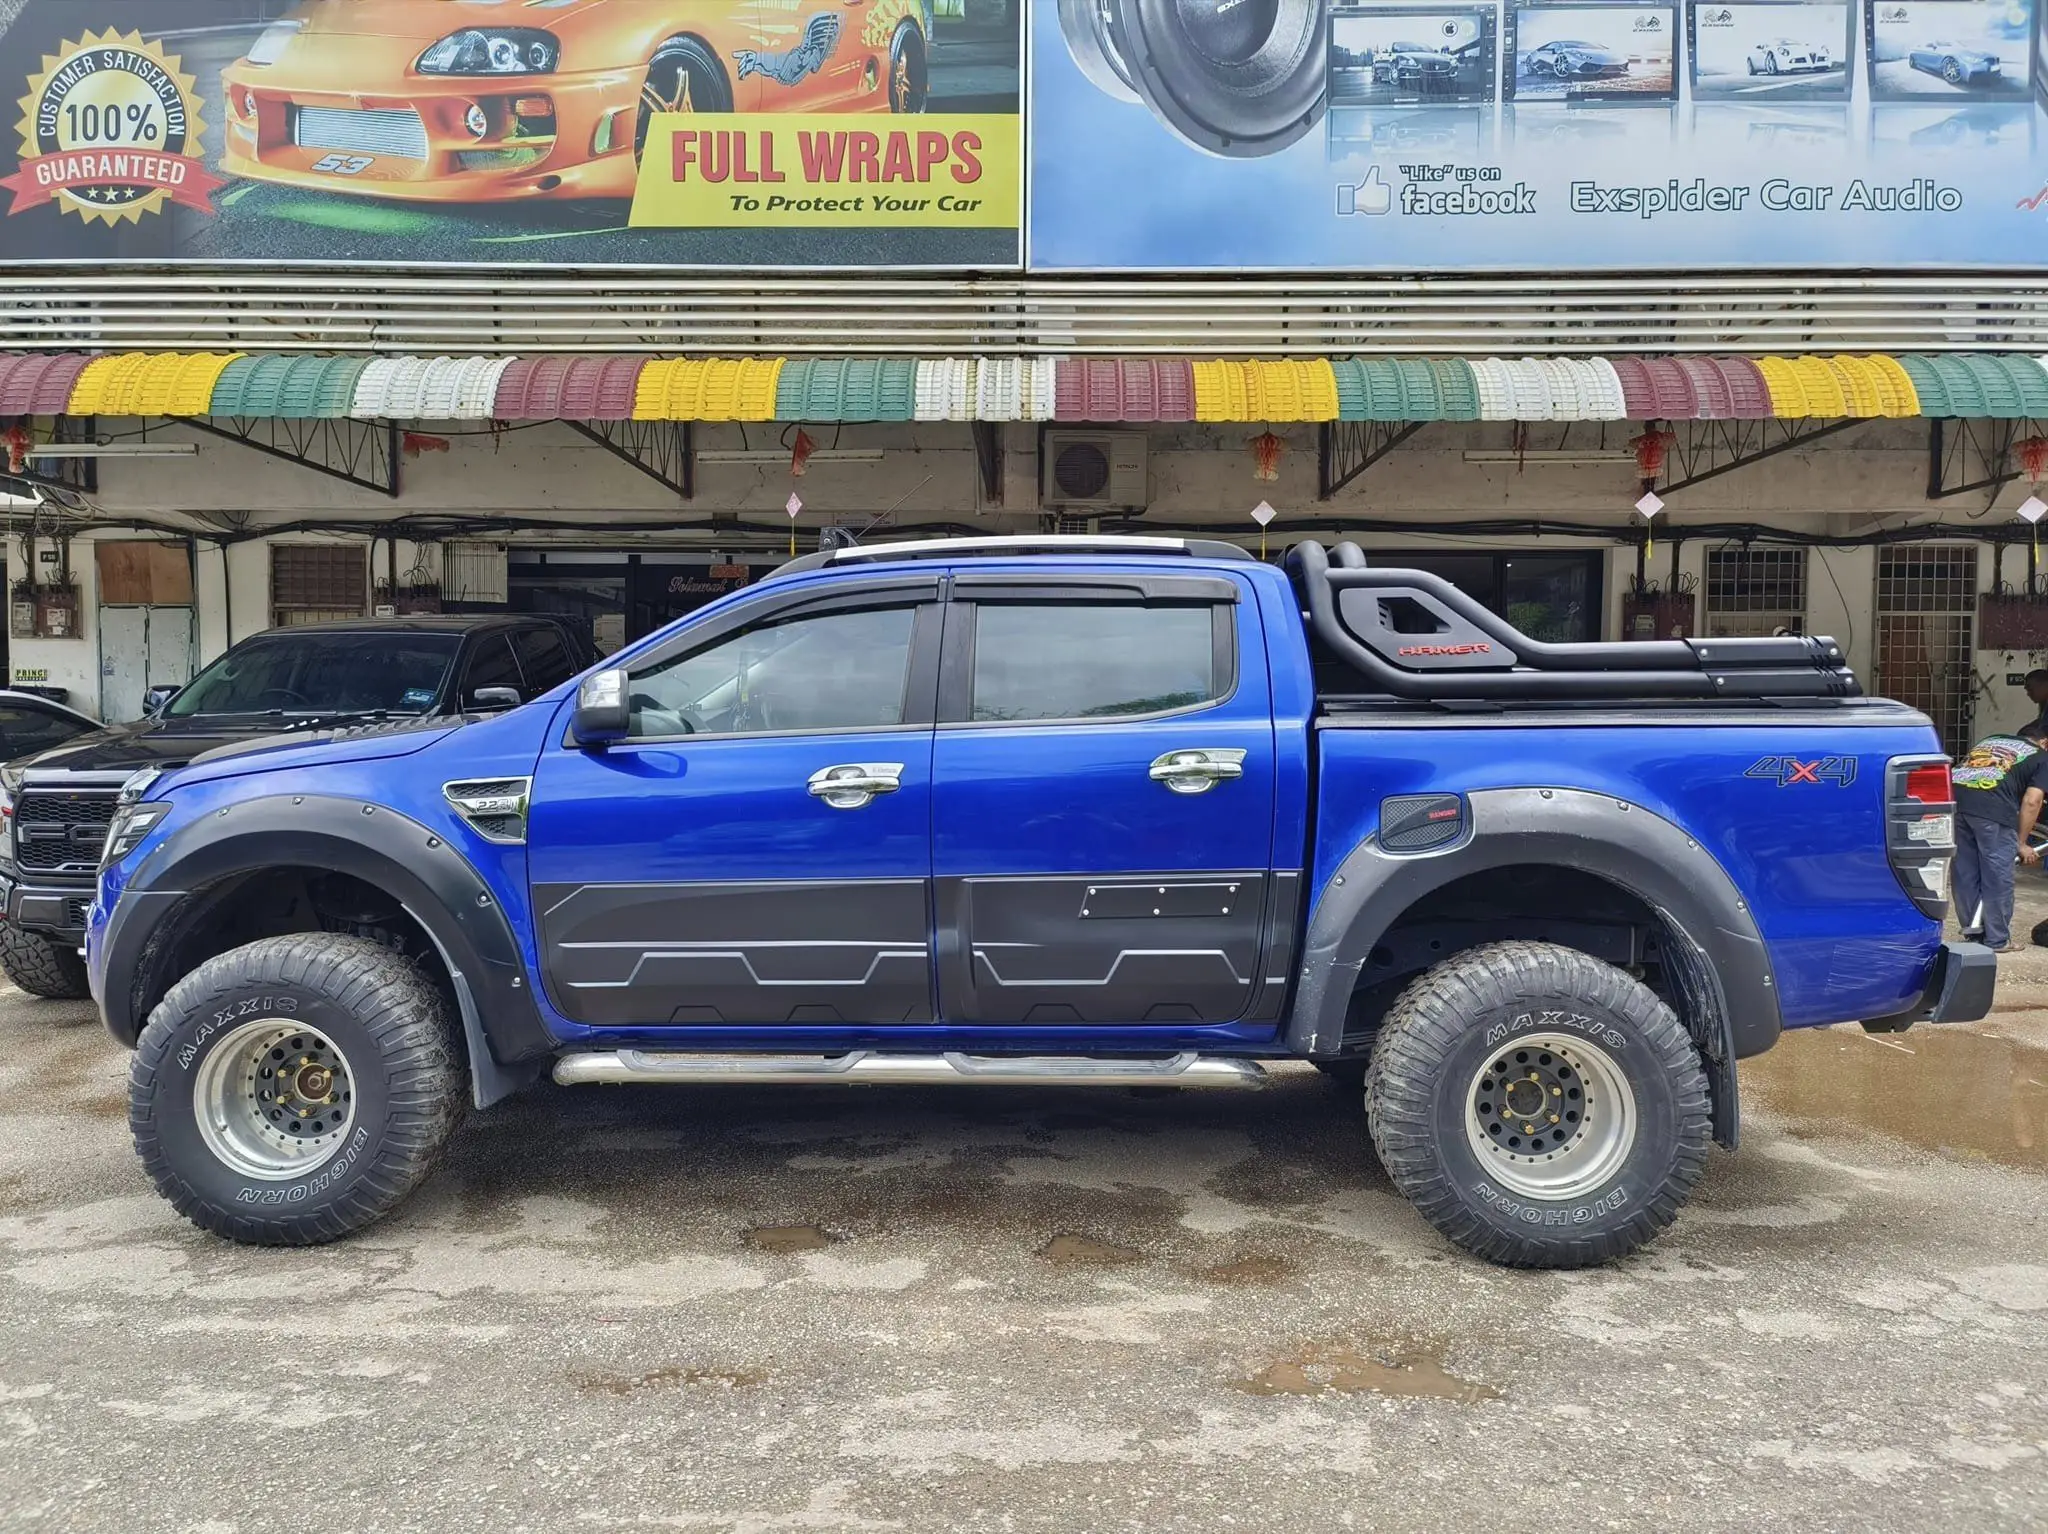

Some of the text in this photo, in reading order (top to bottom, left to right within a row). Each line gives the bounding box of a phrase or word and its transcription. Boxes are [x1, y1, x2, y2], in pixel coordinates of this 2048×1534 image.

[39, 51, 186, 136] CUSTOMER SATISFACTION
[65, 104, 158, 143] 100%
[36, 152, 187, 186] GUARANTEED
[310, 153, 374, 174] 53
[671, 130, 983, 184] FULL WRAPS
[1455, 168, 1477, 182] us
[1479, 168, 1501, 182] on
[729, 195, 983, 213] To Protect Your Car
[1400, 182, 1537, 215] facebook
[1570, 179, 1963, 219] Exspider Car Audio
[177, 997, 297, 1069] MAXXIS
[1486, 1009, 1628, 1049] MAXXIS
[237, 1127, 369, 1204] BIGHORN
[1473, 1182, 1628, 1226] BIGHORN
